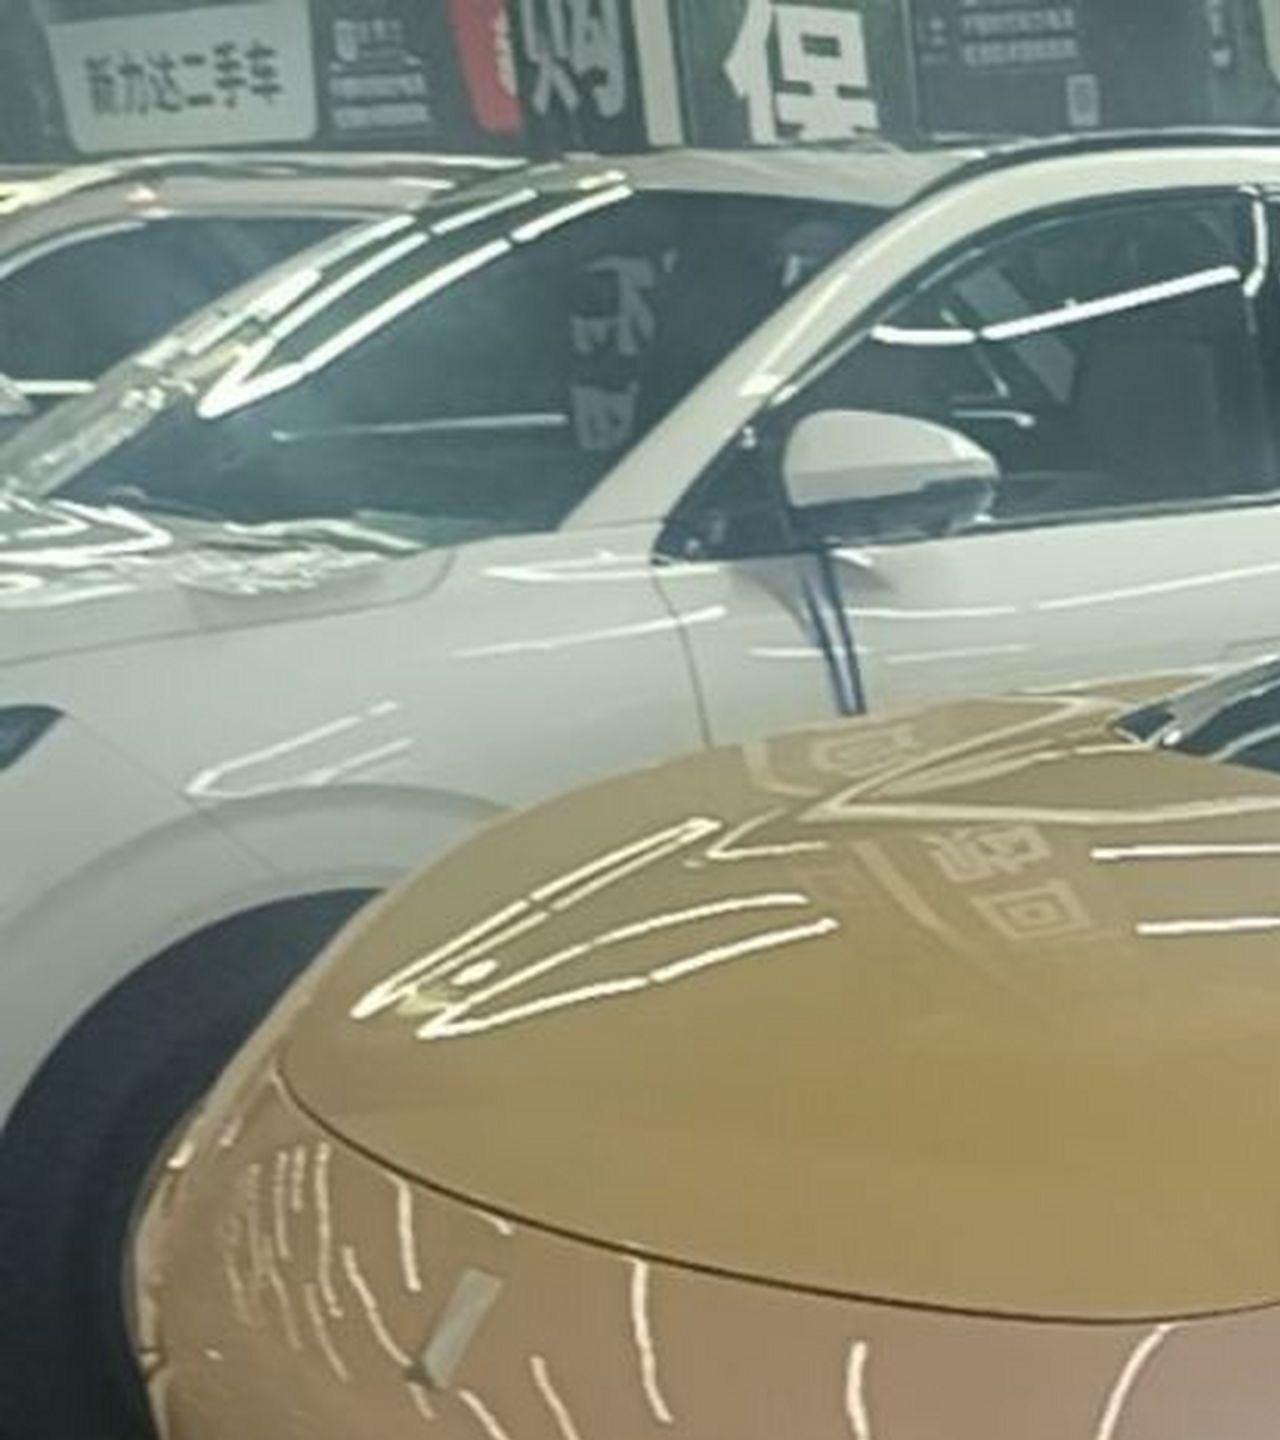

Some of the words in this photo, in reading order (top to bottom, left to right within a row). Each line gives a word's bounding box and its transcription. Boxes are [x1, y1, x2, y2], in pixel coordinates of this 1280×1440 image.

[84, 40, 284, 117] 新力达二手车
[723, 0, 880, 146] 保
